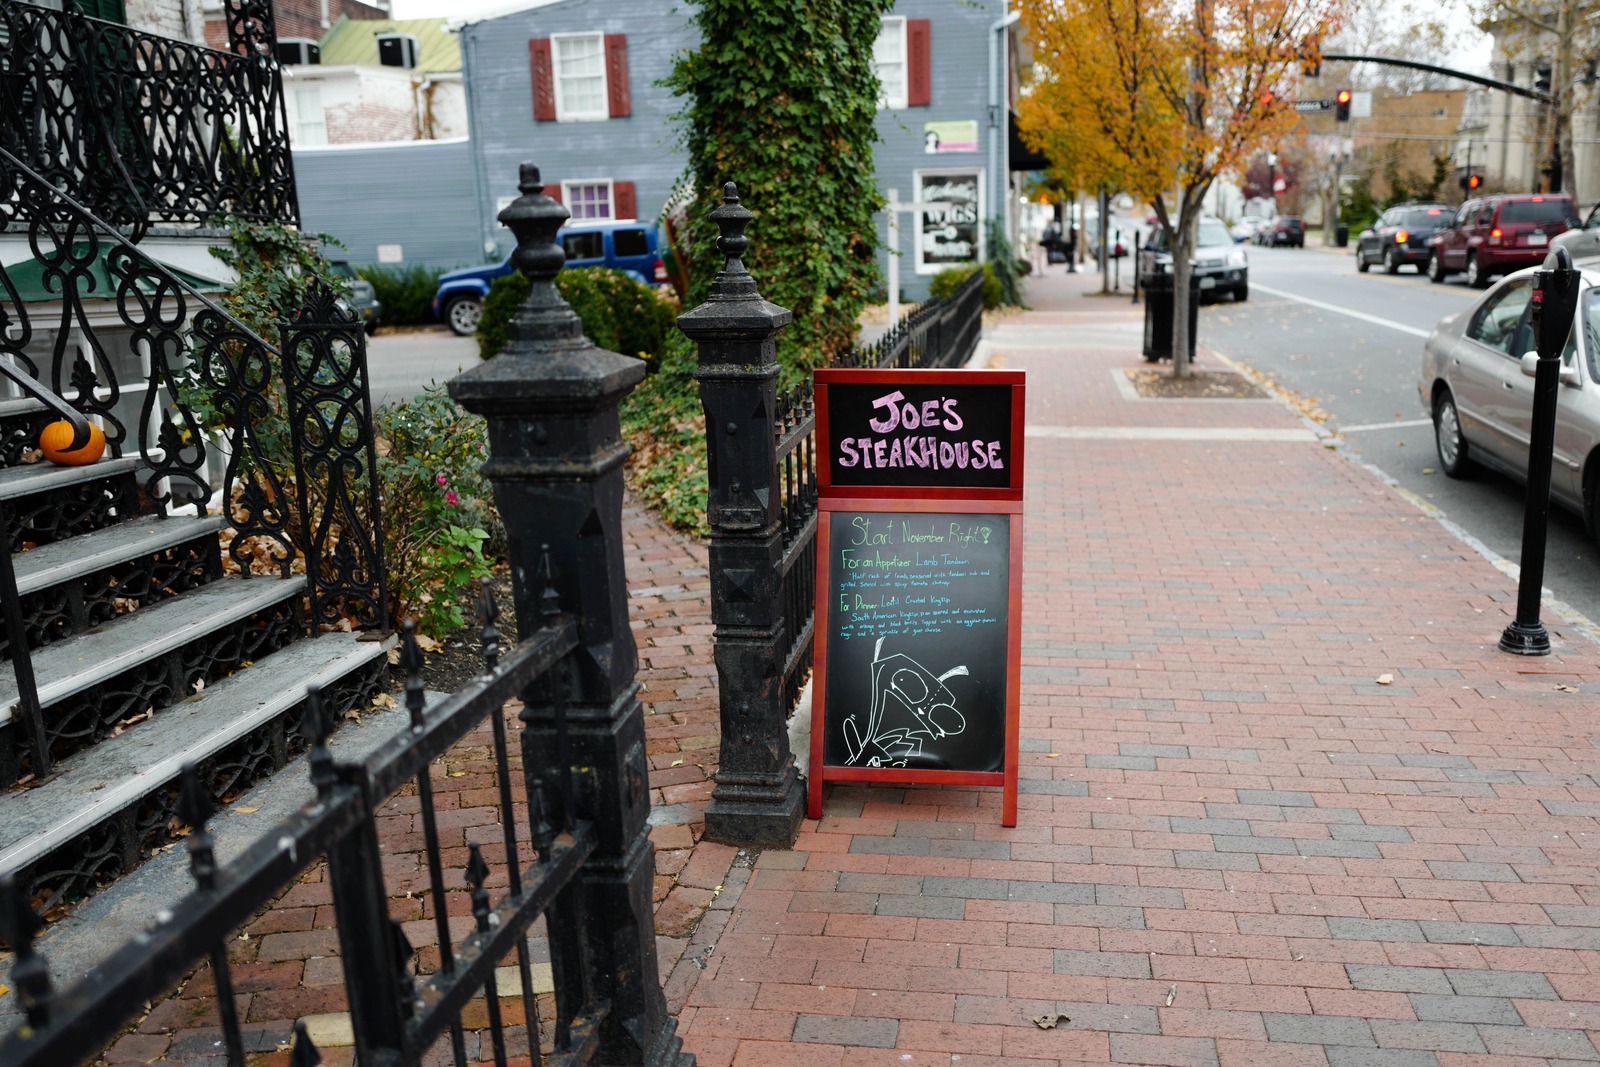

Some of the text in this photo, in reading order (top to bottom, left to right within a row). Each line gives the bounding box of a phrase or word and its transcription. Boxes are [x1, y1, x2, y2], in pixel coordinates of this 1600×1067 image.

[869, 390, 964, 434] JOE'S
[838, 435, 1004, 471] STEAKHOUSE
[851, 516, 894, 546] Start
[902, 520, 945, 544] November
[841, 549, 860, 570] For
[863, 559, 873, 567] an
[916, 552, 938, 566] Lamb
[941, 553, 970, 566] Tandoori
[909, 571, 932, 580] seasoned
[840, 593, 850, 612] For
[881, 594, 900, 608] Lentil
[905, 595, 926, 604] Crusted
[851, 612, 870, 622] South
[872, 611, 898, 620] American
[859, 624, 875, 632] orange
